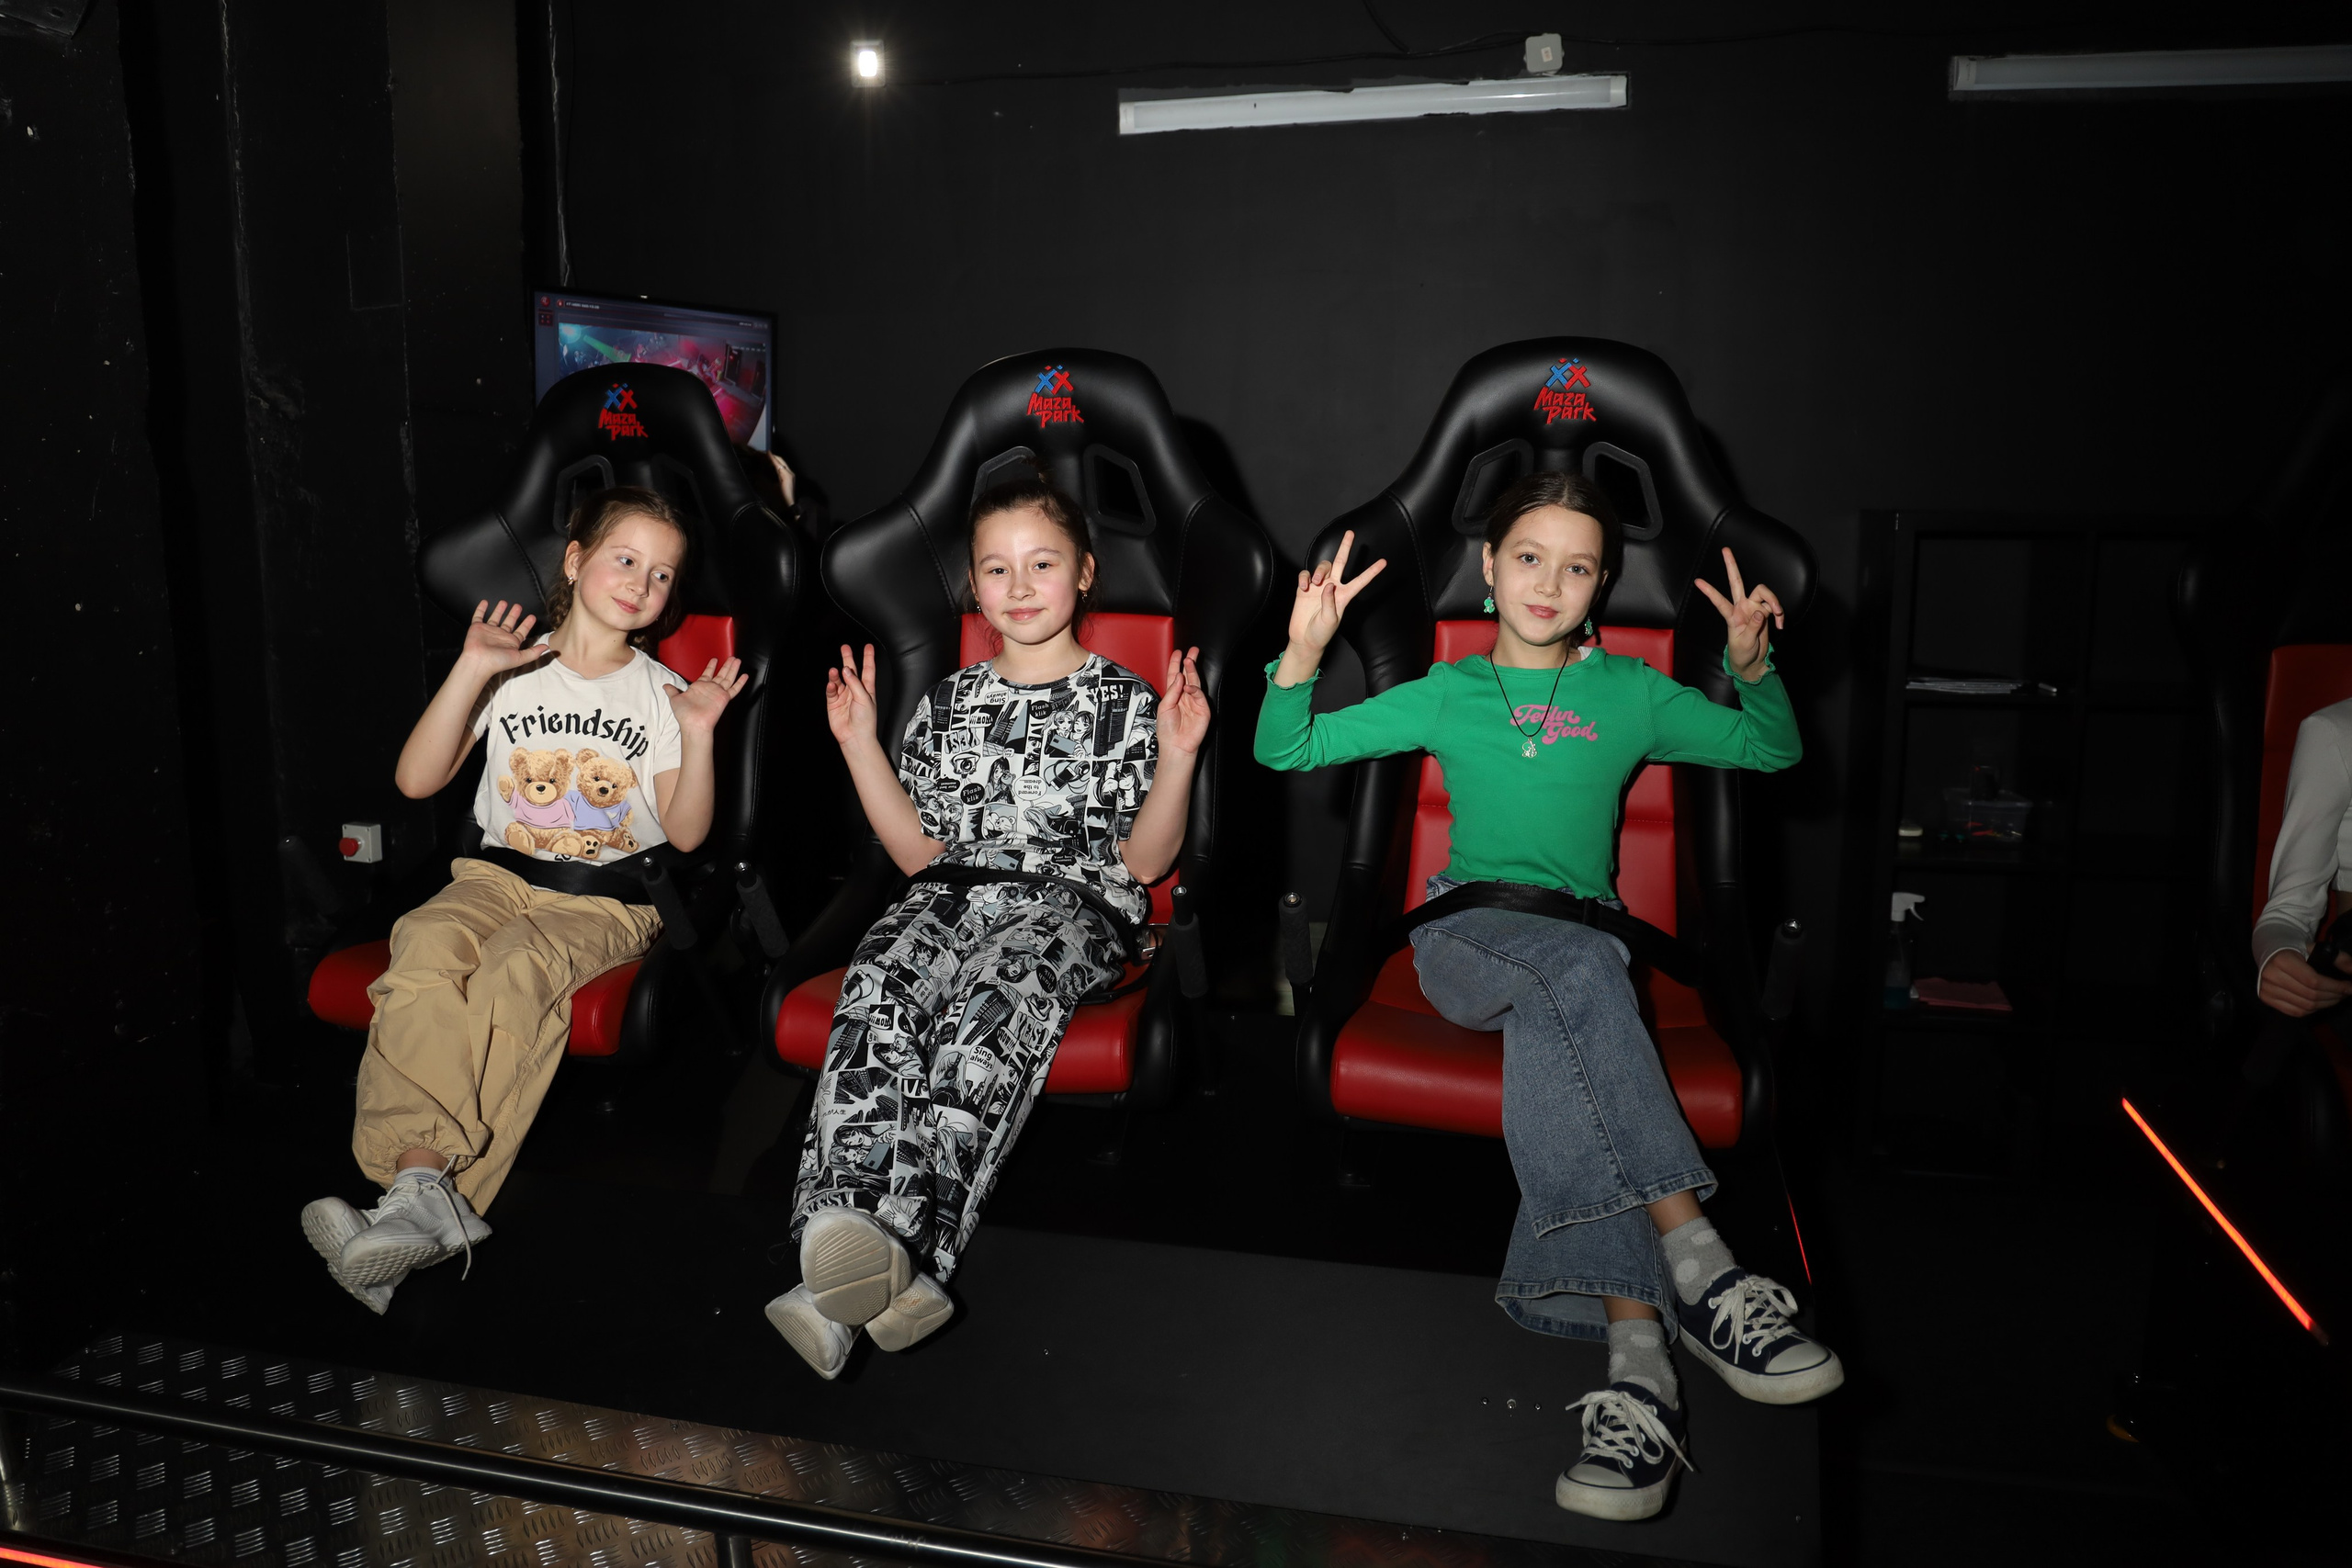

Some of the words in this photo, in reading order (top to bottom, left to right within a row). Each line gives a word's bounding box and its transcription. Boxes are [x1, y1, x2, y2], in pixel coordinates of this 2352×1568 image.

[1026, 392, 1071, 415] Maza
[1533, 386, 1586, 411] Maza
[598, 407, 637, 429] Maza
[1090, 684, 1124, 702] YES!
[1031, 703, 1049, 711] Flash
[500, 705, 649, 761] Friendship
[1541, 721, 1598, 745] Good
[962, 785, 982, 796] Flash
[967, 795, 979, 803] klik
[969, 1055, 993, 1069] always
[974, 1046, 992, 1061] Sing
